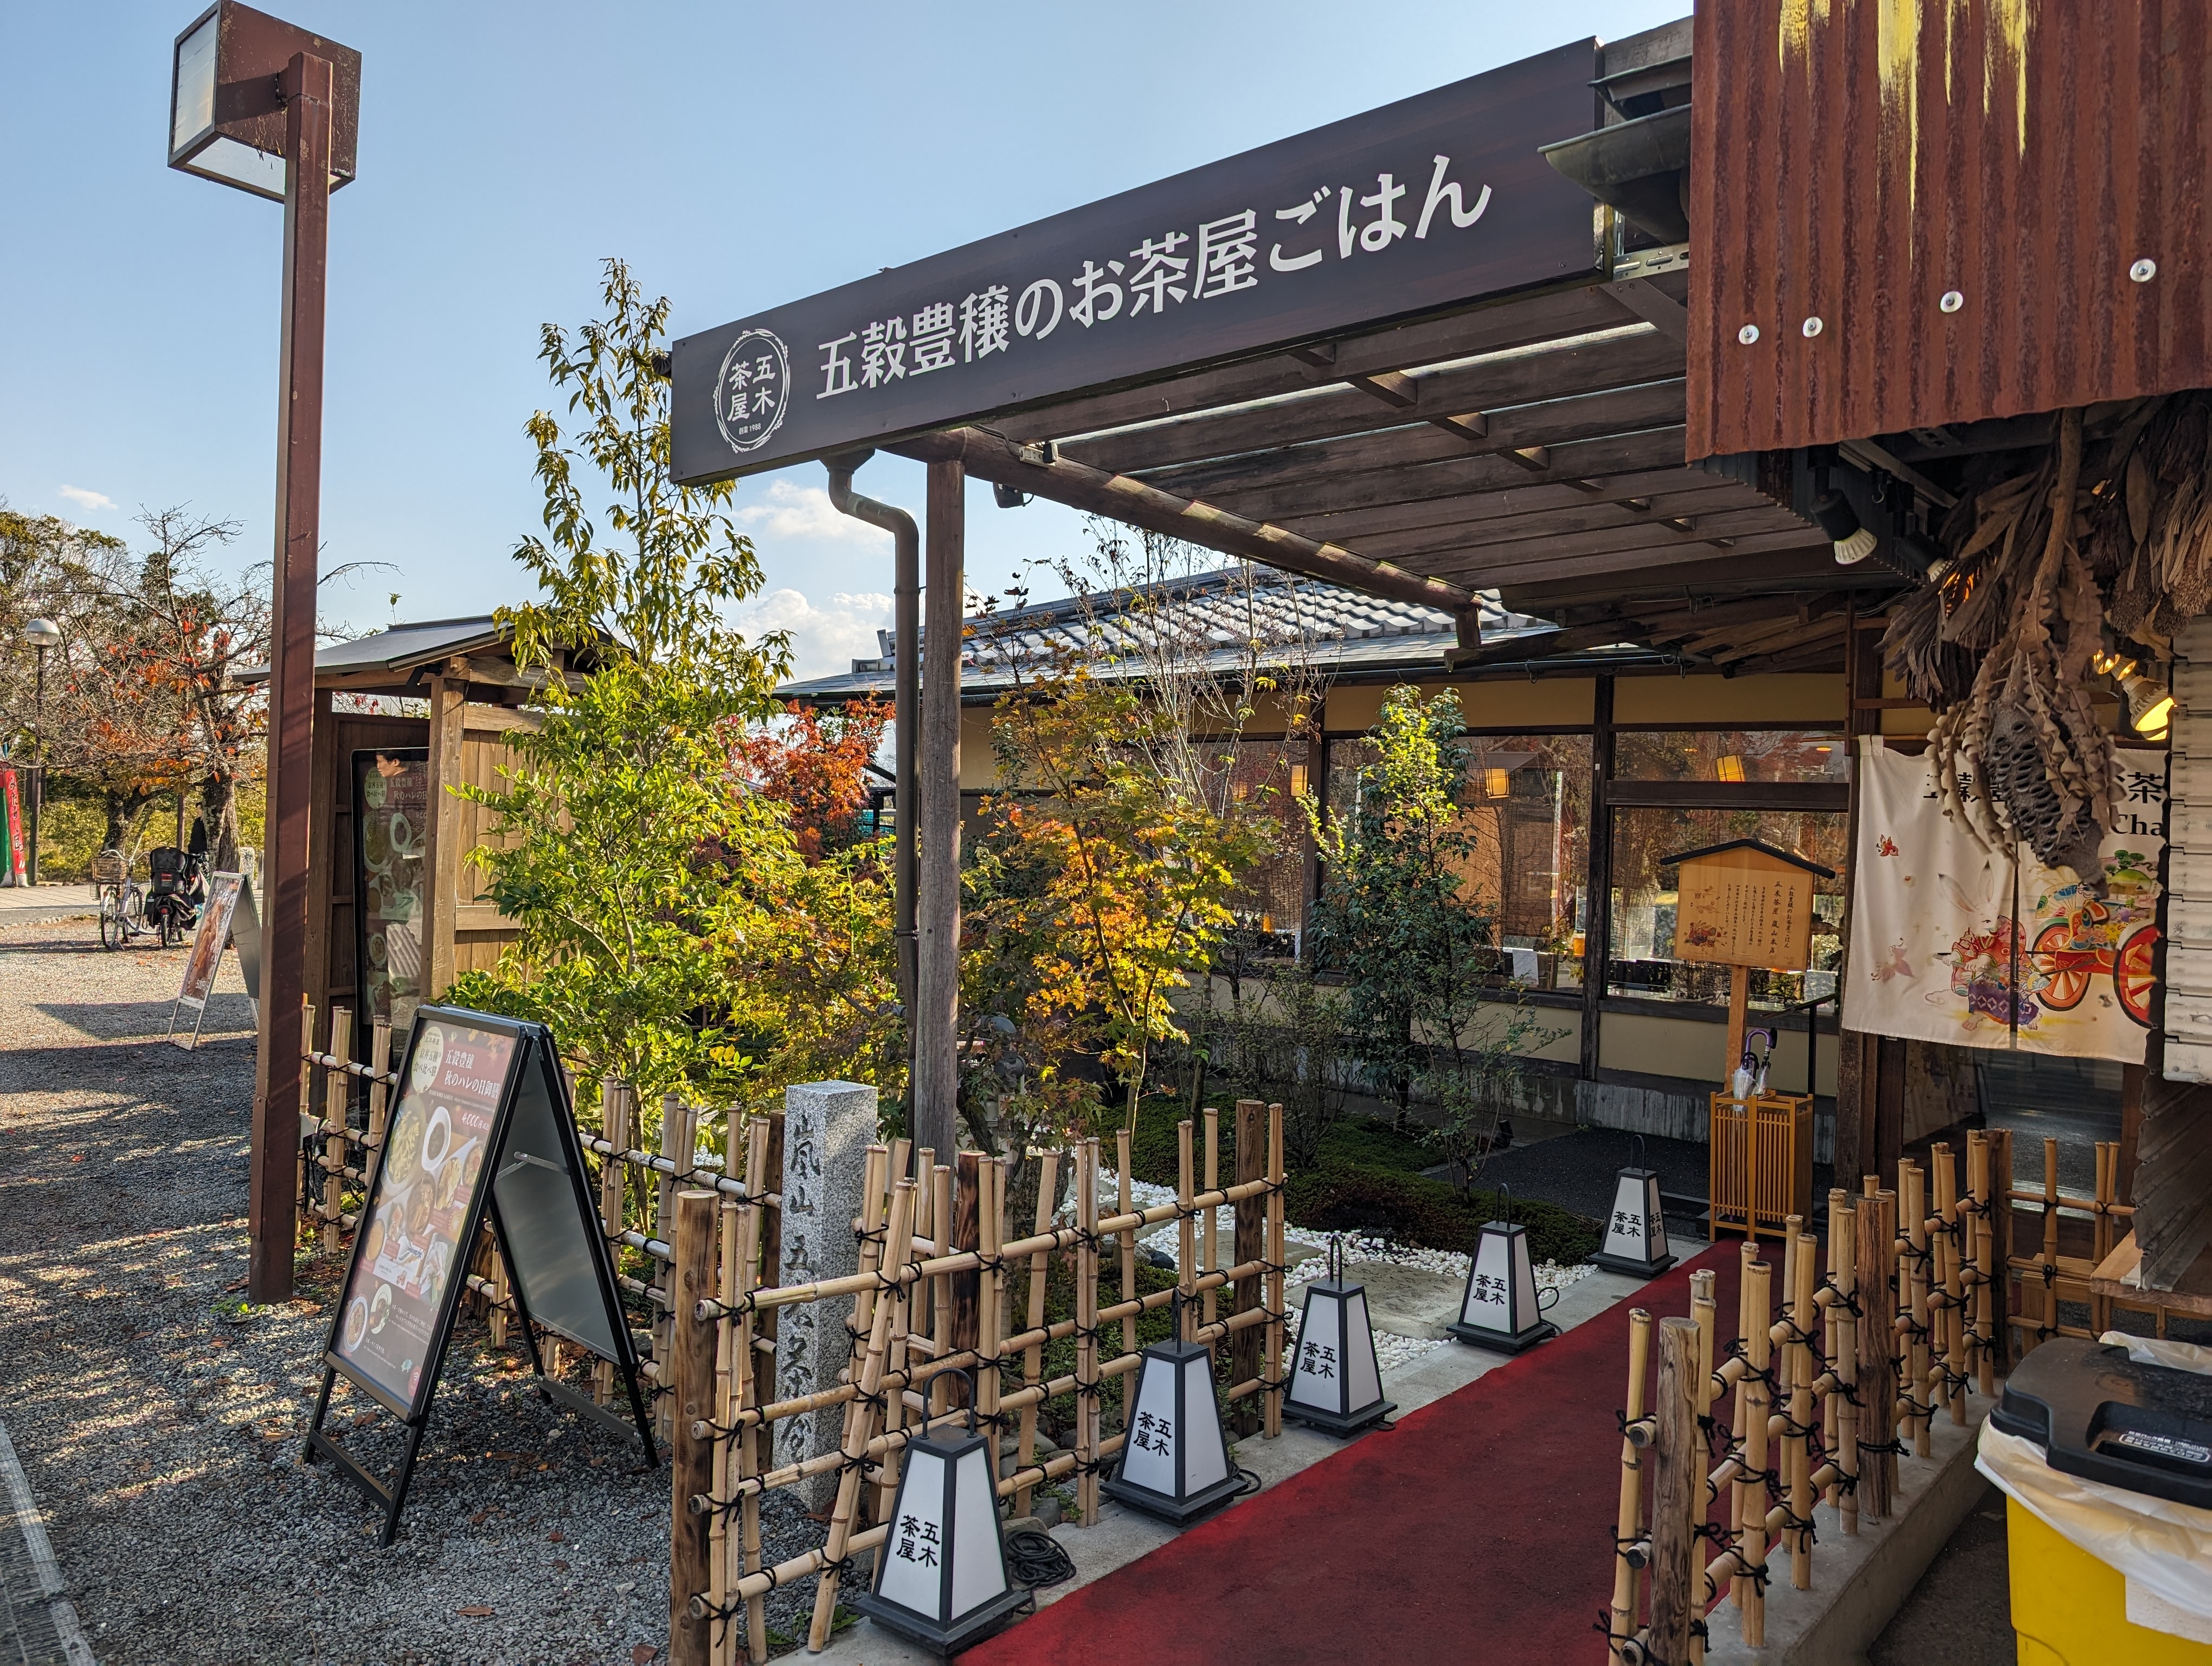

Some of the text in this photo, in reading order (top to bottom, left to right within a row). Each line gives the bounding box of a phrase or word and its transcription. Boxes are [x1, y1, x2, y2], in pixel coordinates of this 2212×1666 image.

[816, 155, 1493, 401] 五穀豊穣のお茶屋ごはん
[749, 423, 761, 432] 1988
[1772, 881, 1782, 915] 五木茶屋
[445, 1049, 475, 1069] 五穀豊穣
